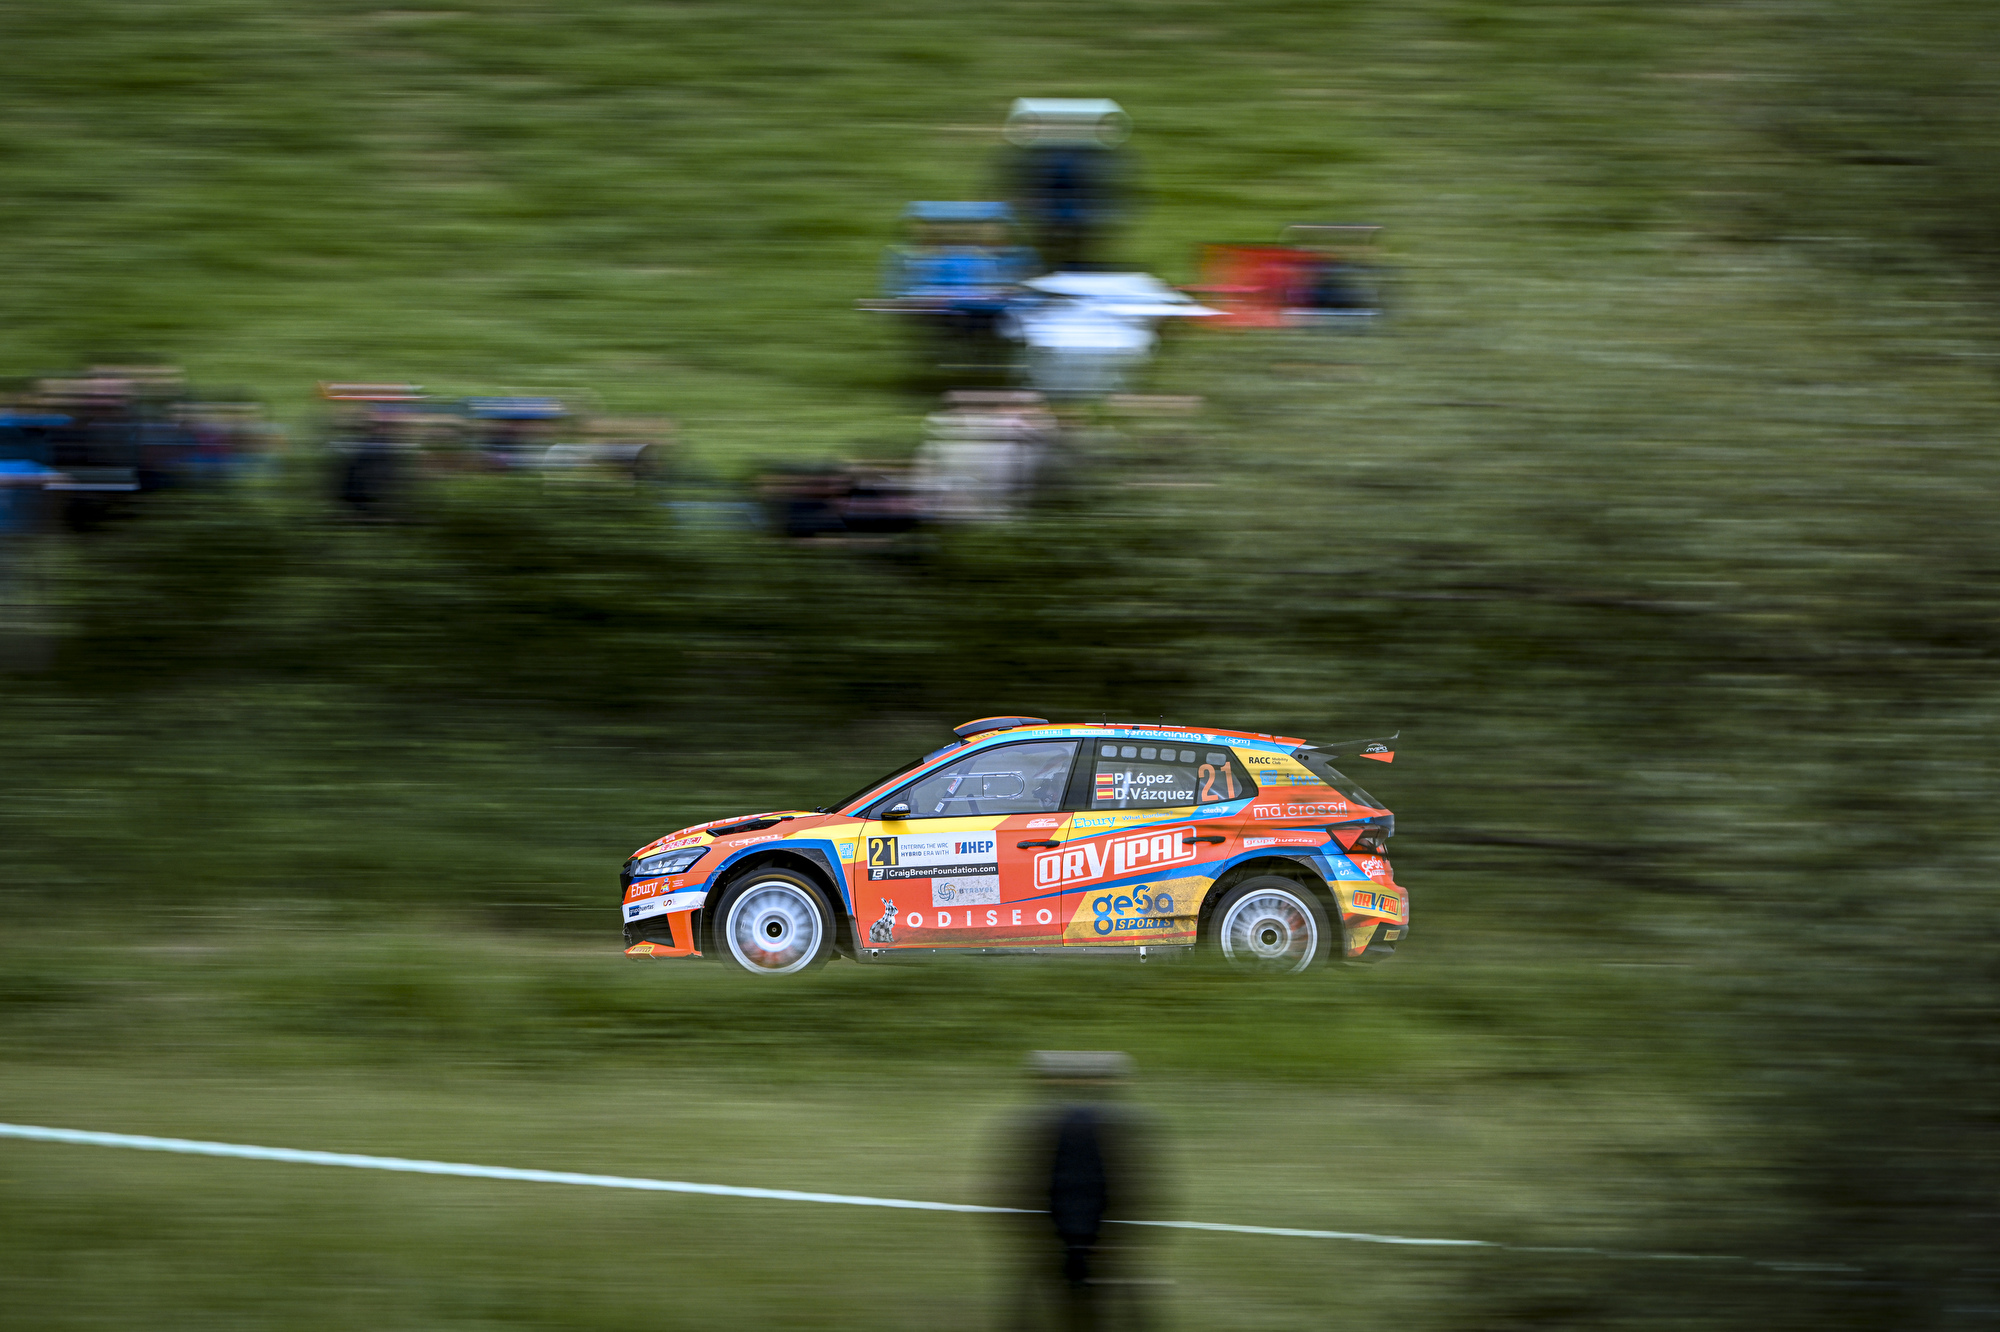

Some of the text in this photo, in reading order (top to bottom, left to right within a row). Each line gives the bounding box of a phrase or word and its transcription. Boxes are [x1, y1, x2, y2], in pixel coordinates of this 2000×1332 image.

[1124, 729, 1201, 740] terratraining
[1198, 762, 1236, 802] 21
[1074, 815, 1116, 829] Ebury
[1142, 811, 1173, 820] borders?
[870, 838, 897, 866] 21
[968, 841, 994, 854] HEP
[889, 866, 996, 878] CraigBreenFoundation.com
[631, 882, 658, 898] Ebury
[906, 909, 1053, 928] ODISEO
[1118, 918, 1171, 929] SPORTS
